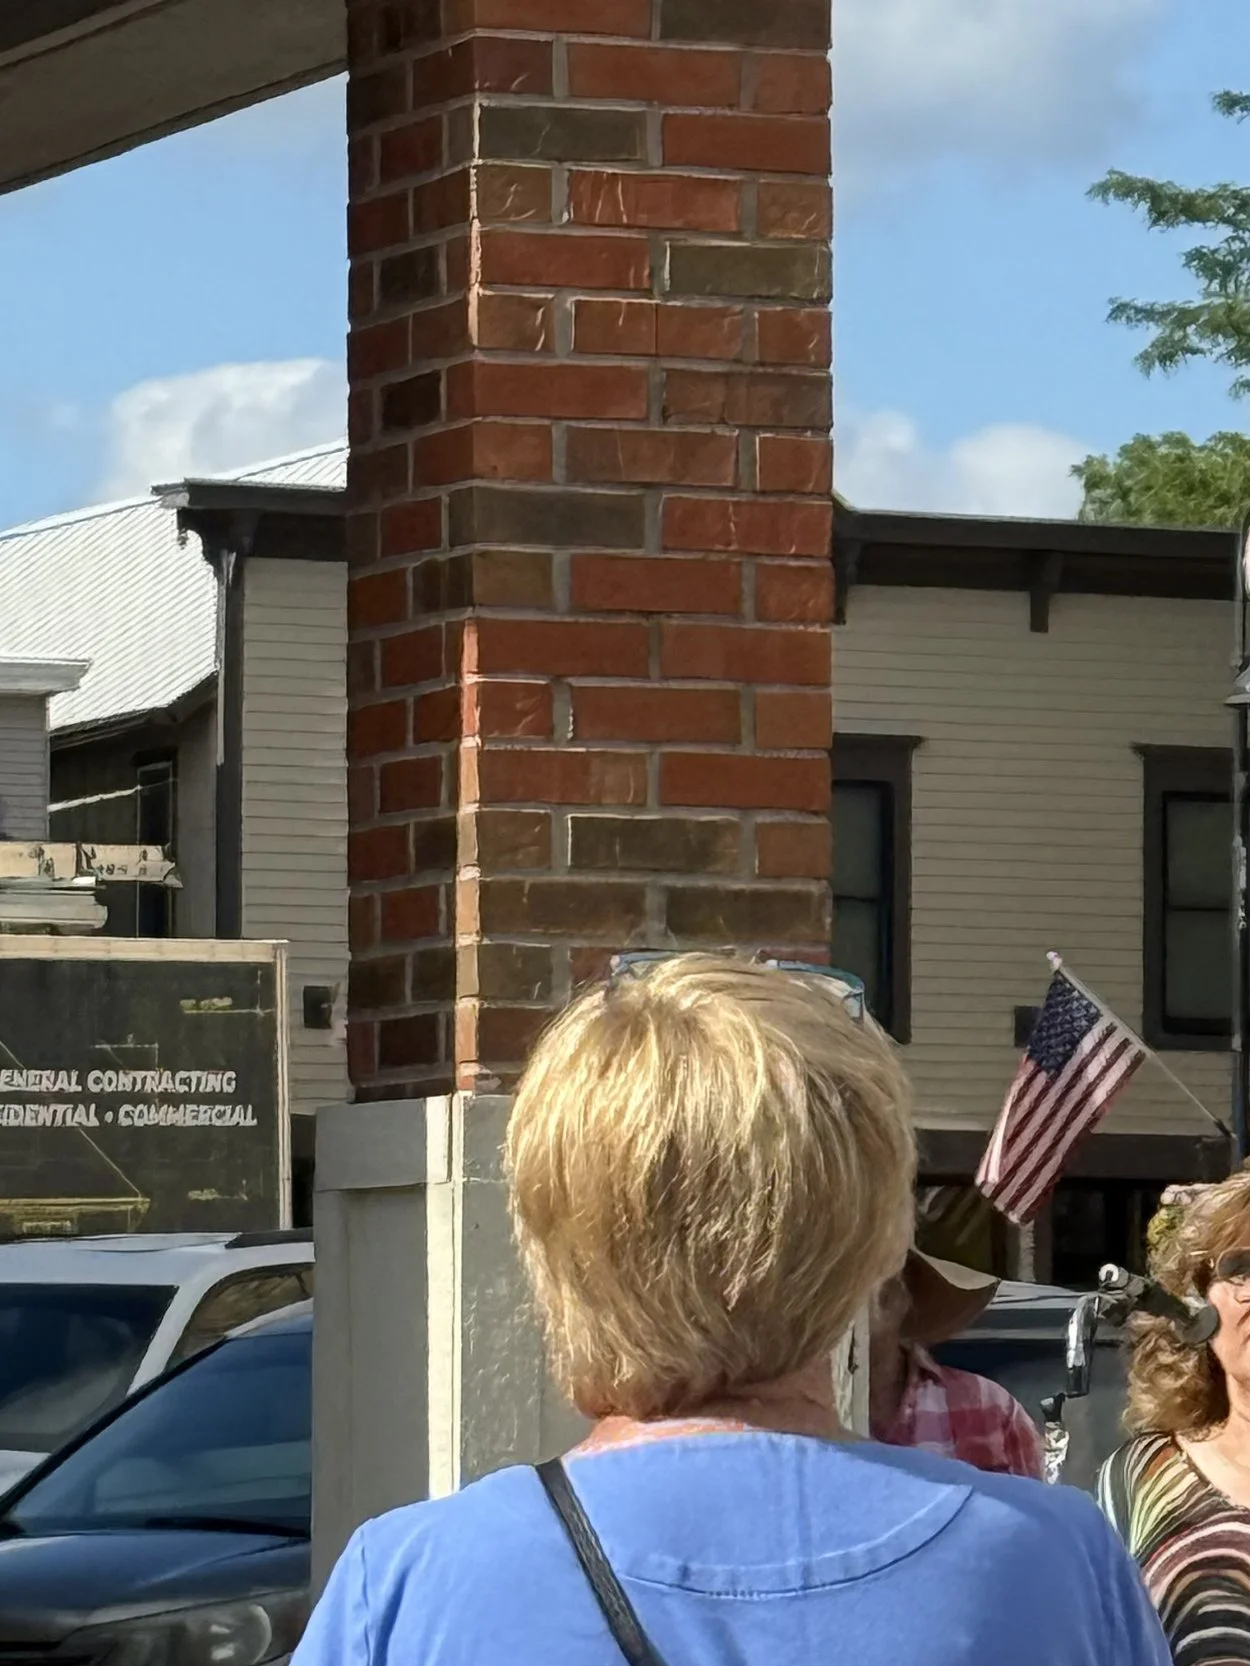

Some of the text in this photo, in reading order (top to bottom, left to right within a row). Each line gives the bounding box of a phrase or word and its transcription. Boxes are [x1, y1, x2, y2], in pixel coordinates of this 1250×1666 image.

[0, 1069, 237, 1094] ENERAL CONTRACTING
[118, 1103, 258, 1127] COMMERCIAL
